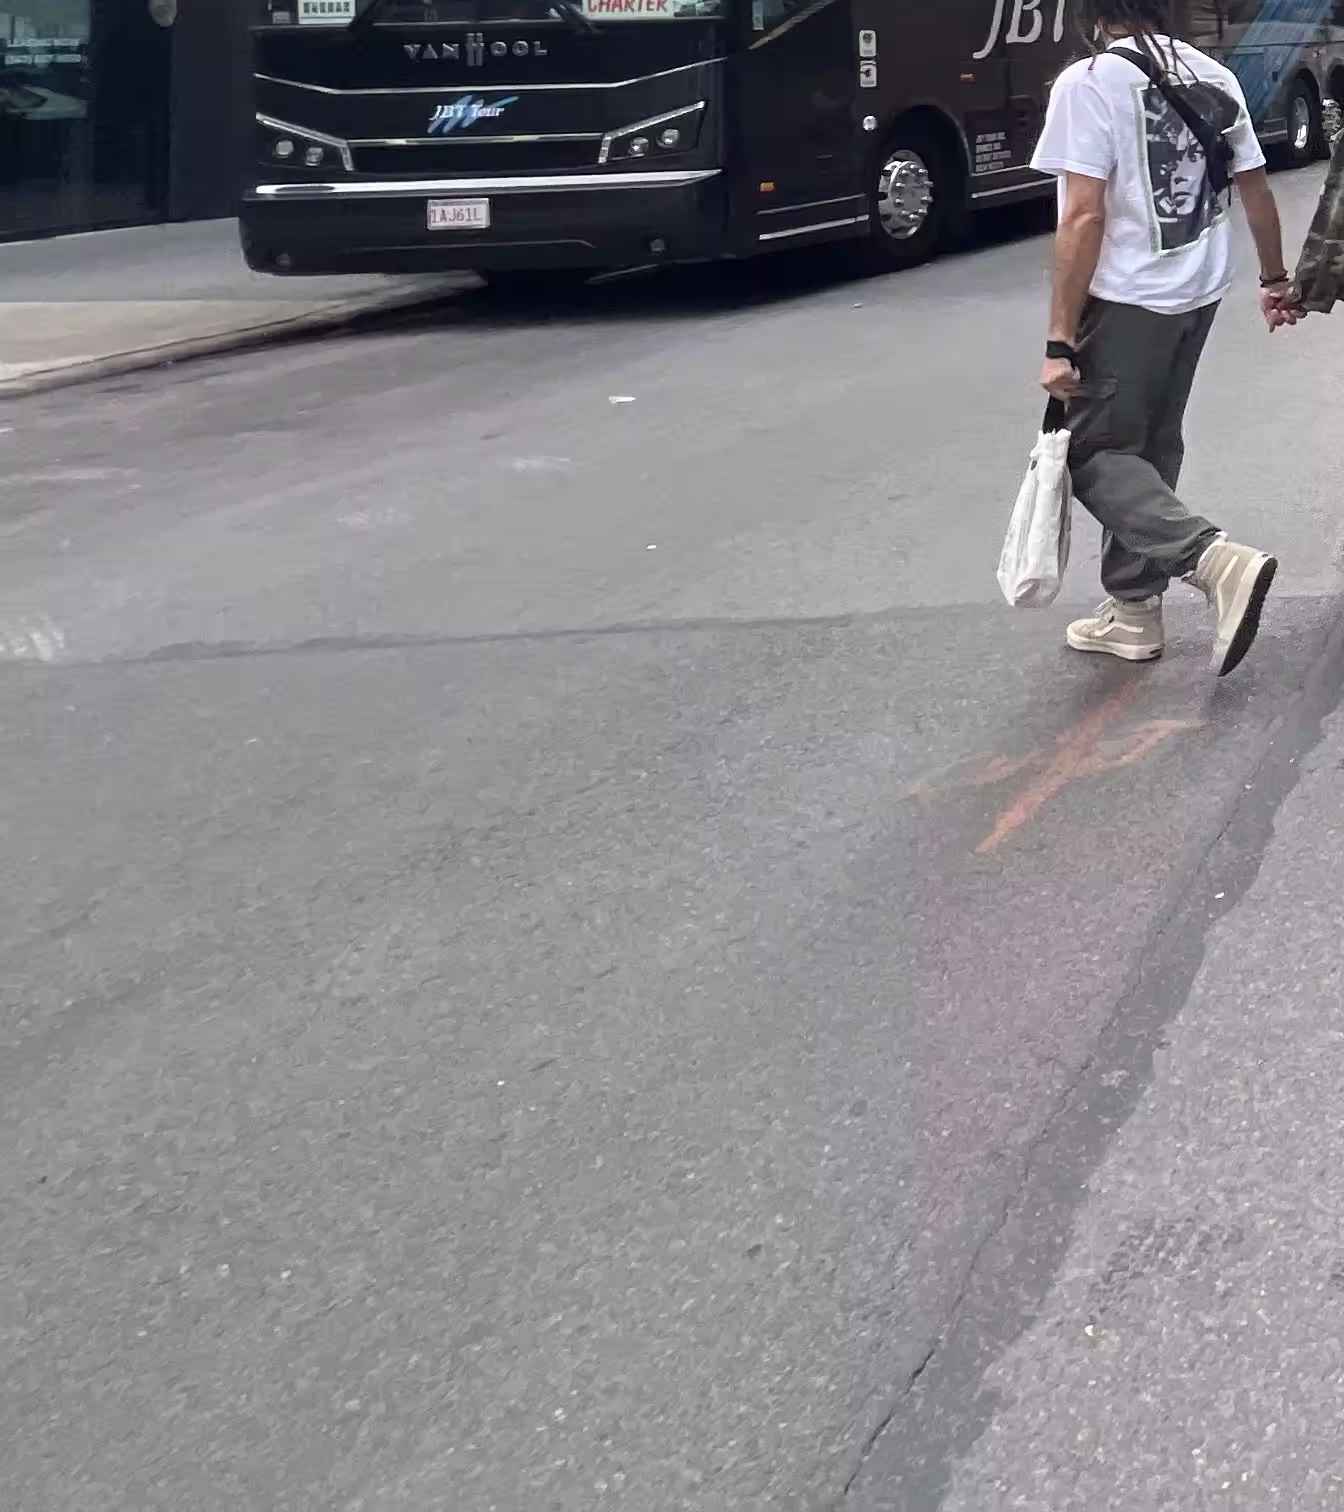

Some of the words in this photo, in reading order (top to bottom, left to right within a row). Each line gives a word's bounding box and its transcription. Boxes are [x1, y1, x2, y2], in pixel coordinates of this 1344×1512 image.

[403, 42, 460, 61] VAN
[428, 104, 467, 121] JBT
[470, 100, 505, 118] Tour
